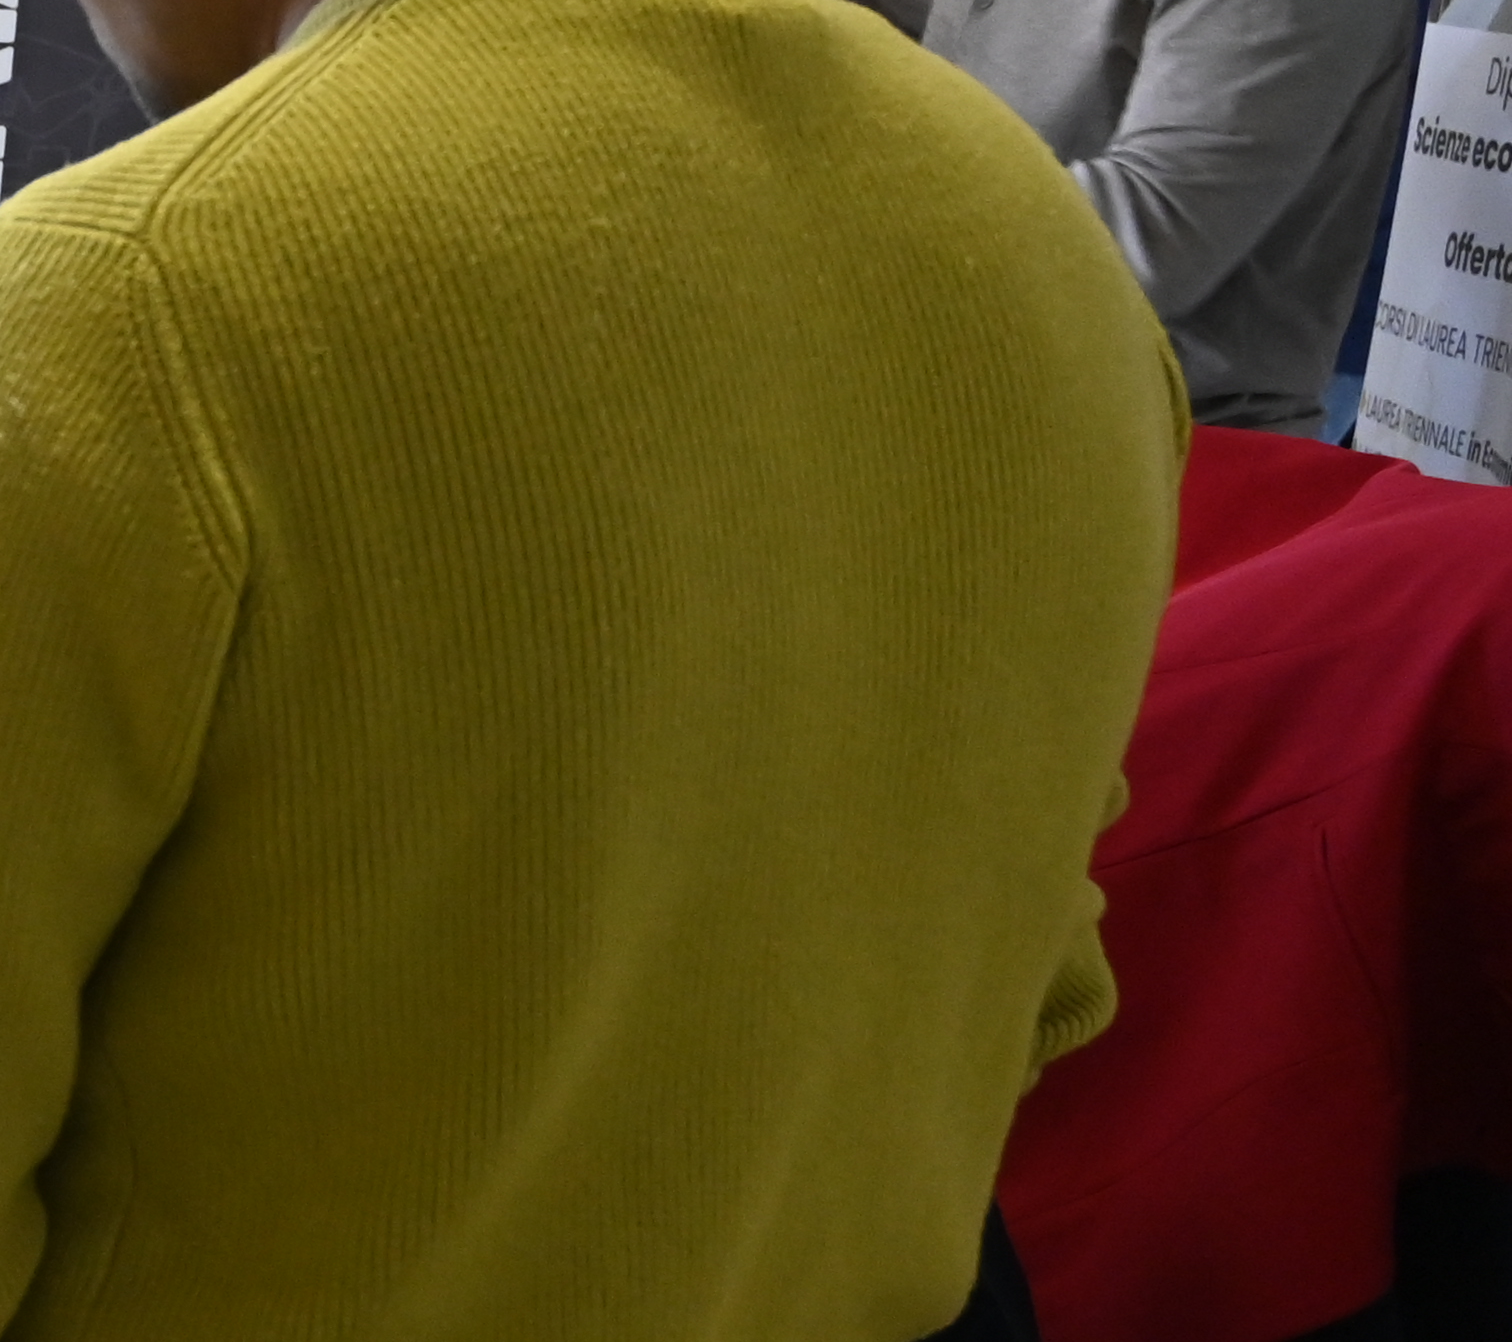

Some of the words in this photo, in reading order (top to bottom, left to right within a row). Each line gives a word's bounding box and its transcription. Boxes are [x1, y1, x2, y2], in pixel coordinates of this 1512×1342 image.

[1486, 56, 1512, 111] Dip
[1414, 115, 1471, 164] Scienze
[1472, 137, 1512, 172] eco
[1418, 316, 1466, 360] LAUREA
[1473, 333, 1512, 375] TRIEN
[1401, 408, 1466, 458] TRIENNALE
